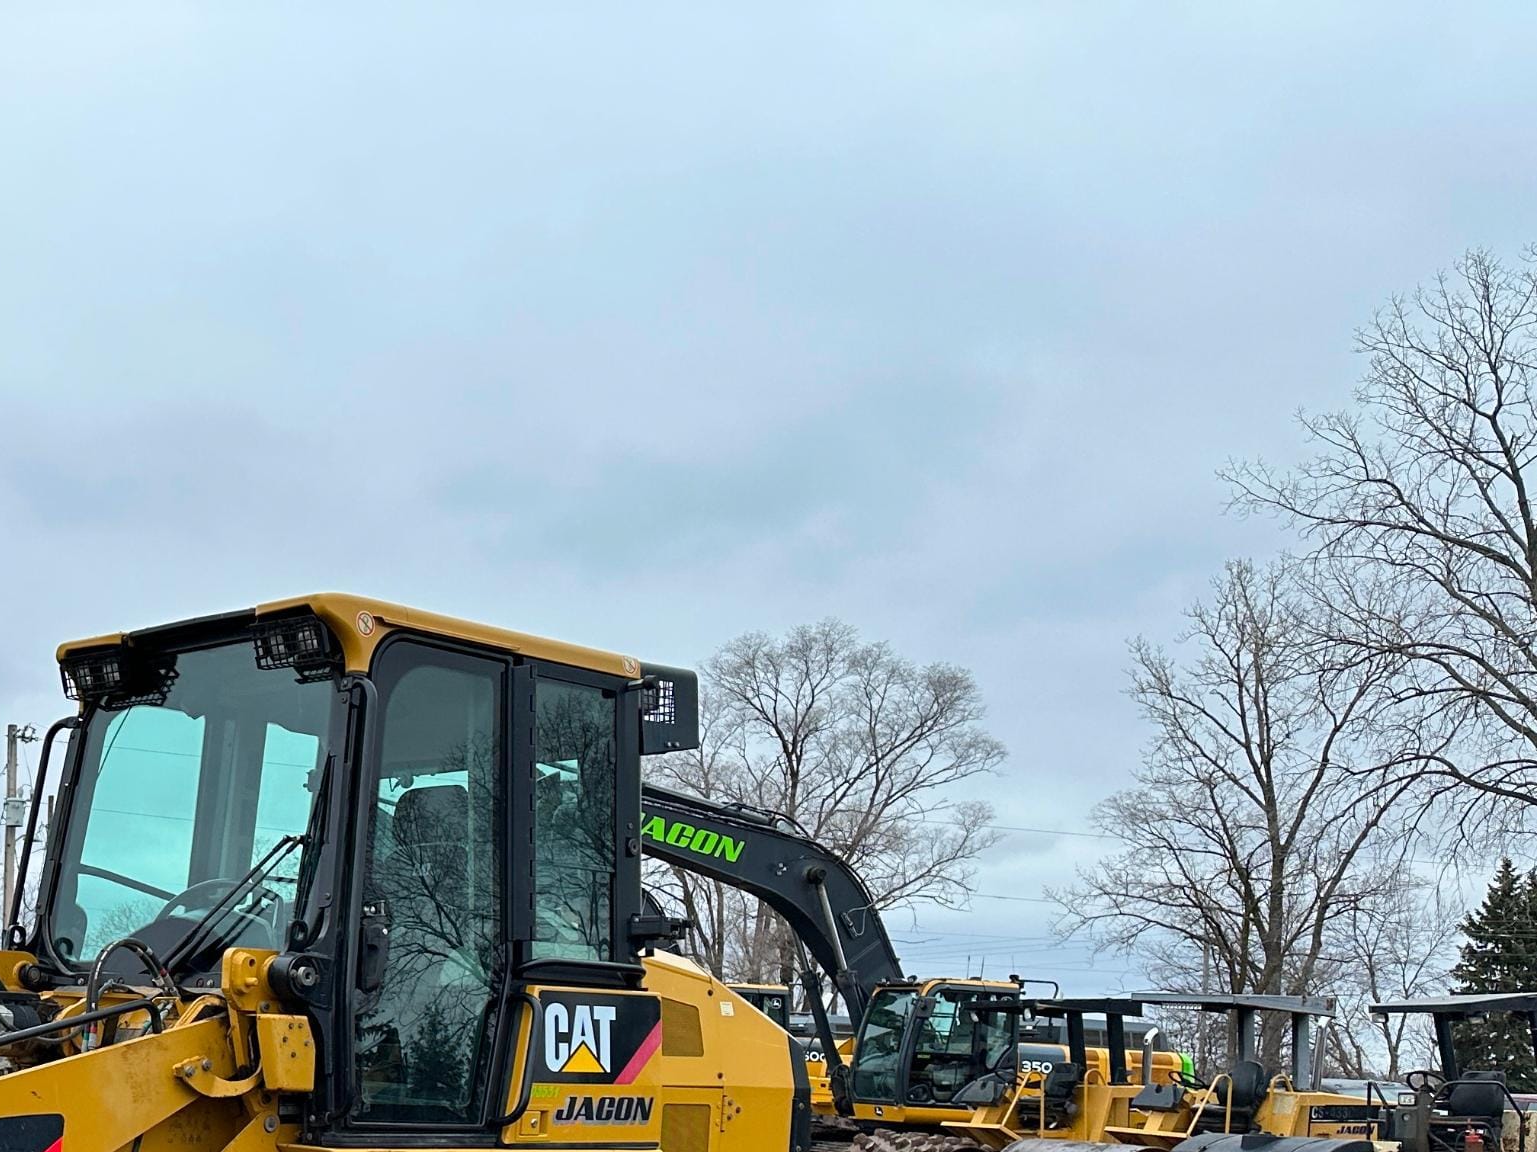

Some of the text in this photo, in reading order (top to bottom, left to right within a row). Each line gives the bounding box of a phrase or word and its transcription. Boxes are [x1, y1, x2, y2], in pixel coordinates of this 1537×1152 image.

[545, 1002, 616, 1073] CAT
[1021, 1060, 1053, 1074] 350
[554, 1096, 654, 1124] JACON
